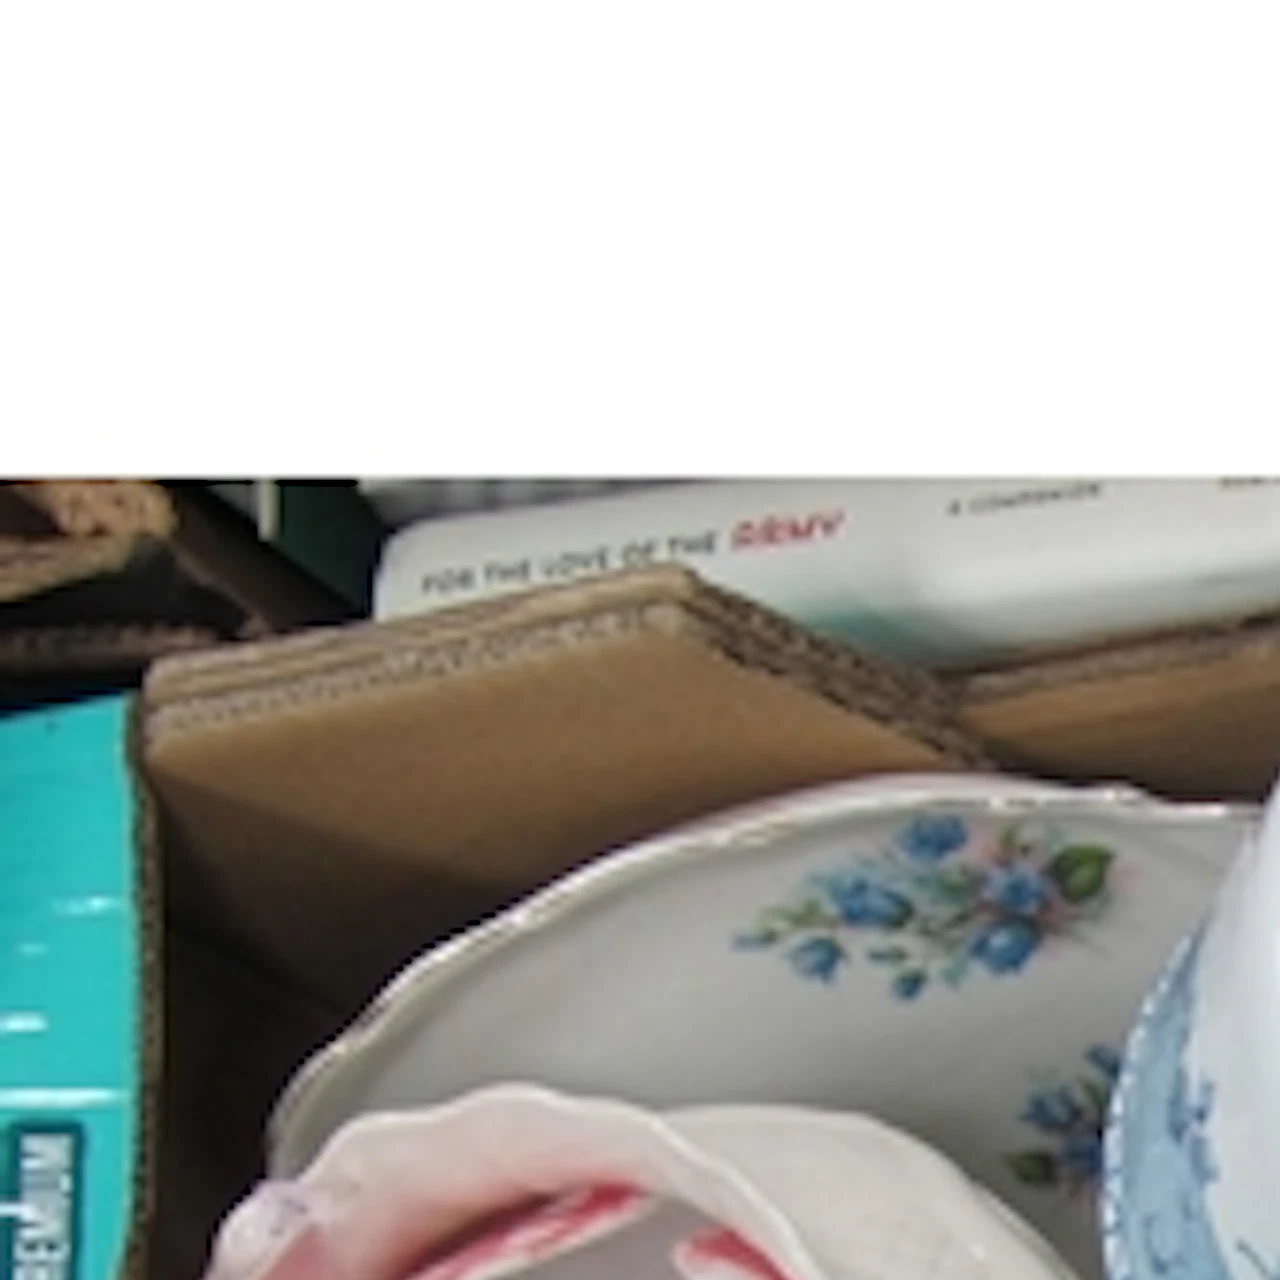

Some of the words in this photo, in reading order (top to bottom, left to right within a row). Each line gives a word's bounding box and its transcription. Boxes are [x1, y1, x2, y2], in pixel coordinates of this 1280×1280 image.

[484, 558, 530, 585] THE
[541, 547, 611, 578] LOVE
[667, 529, 719, 557] THE
